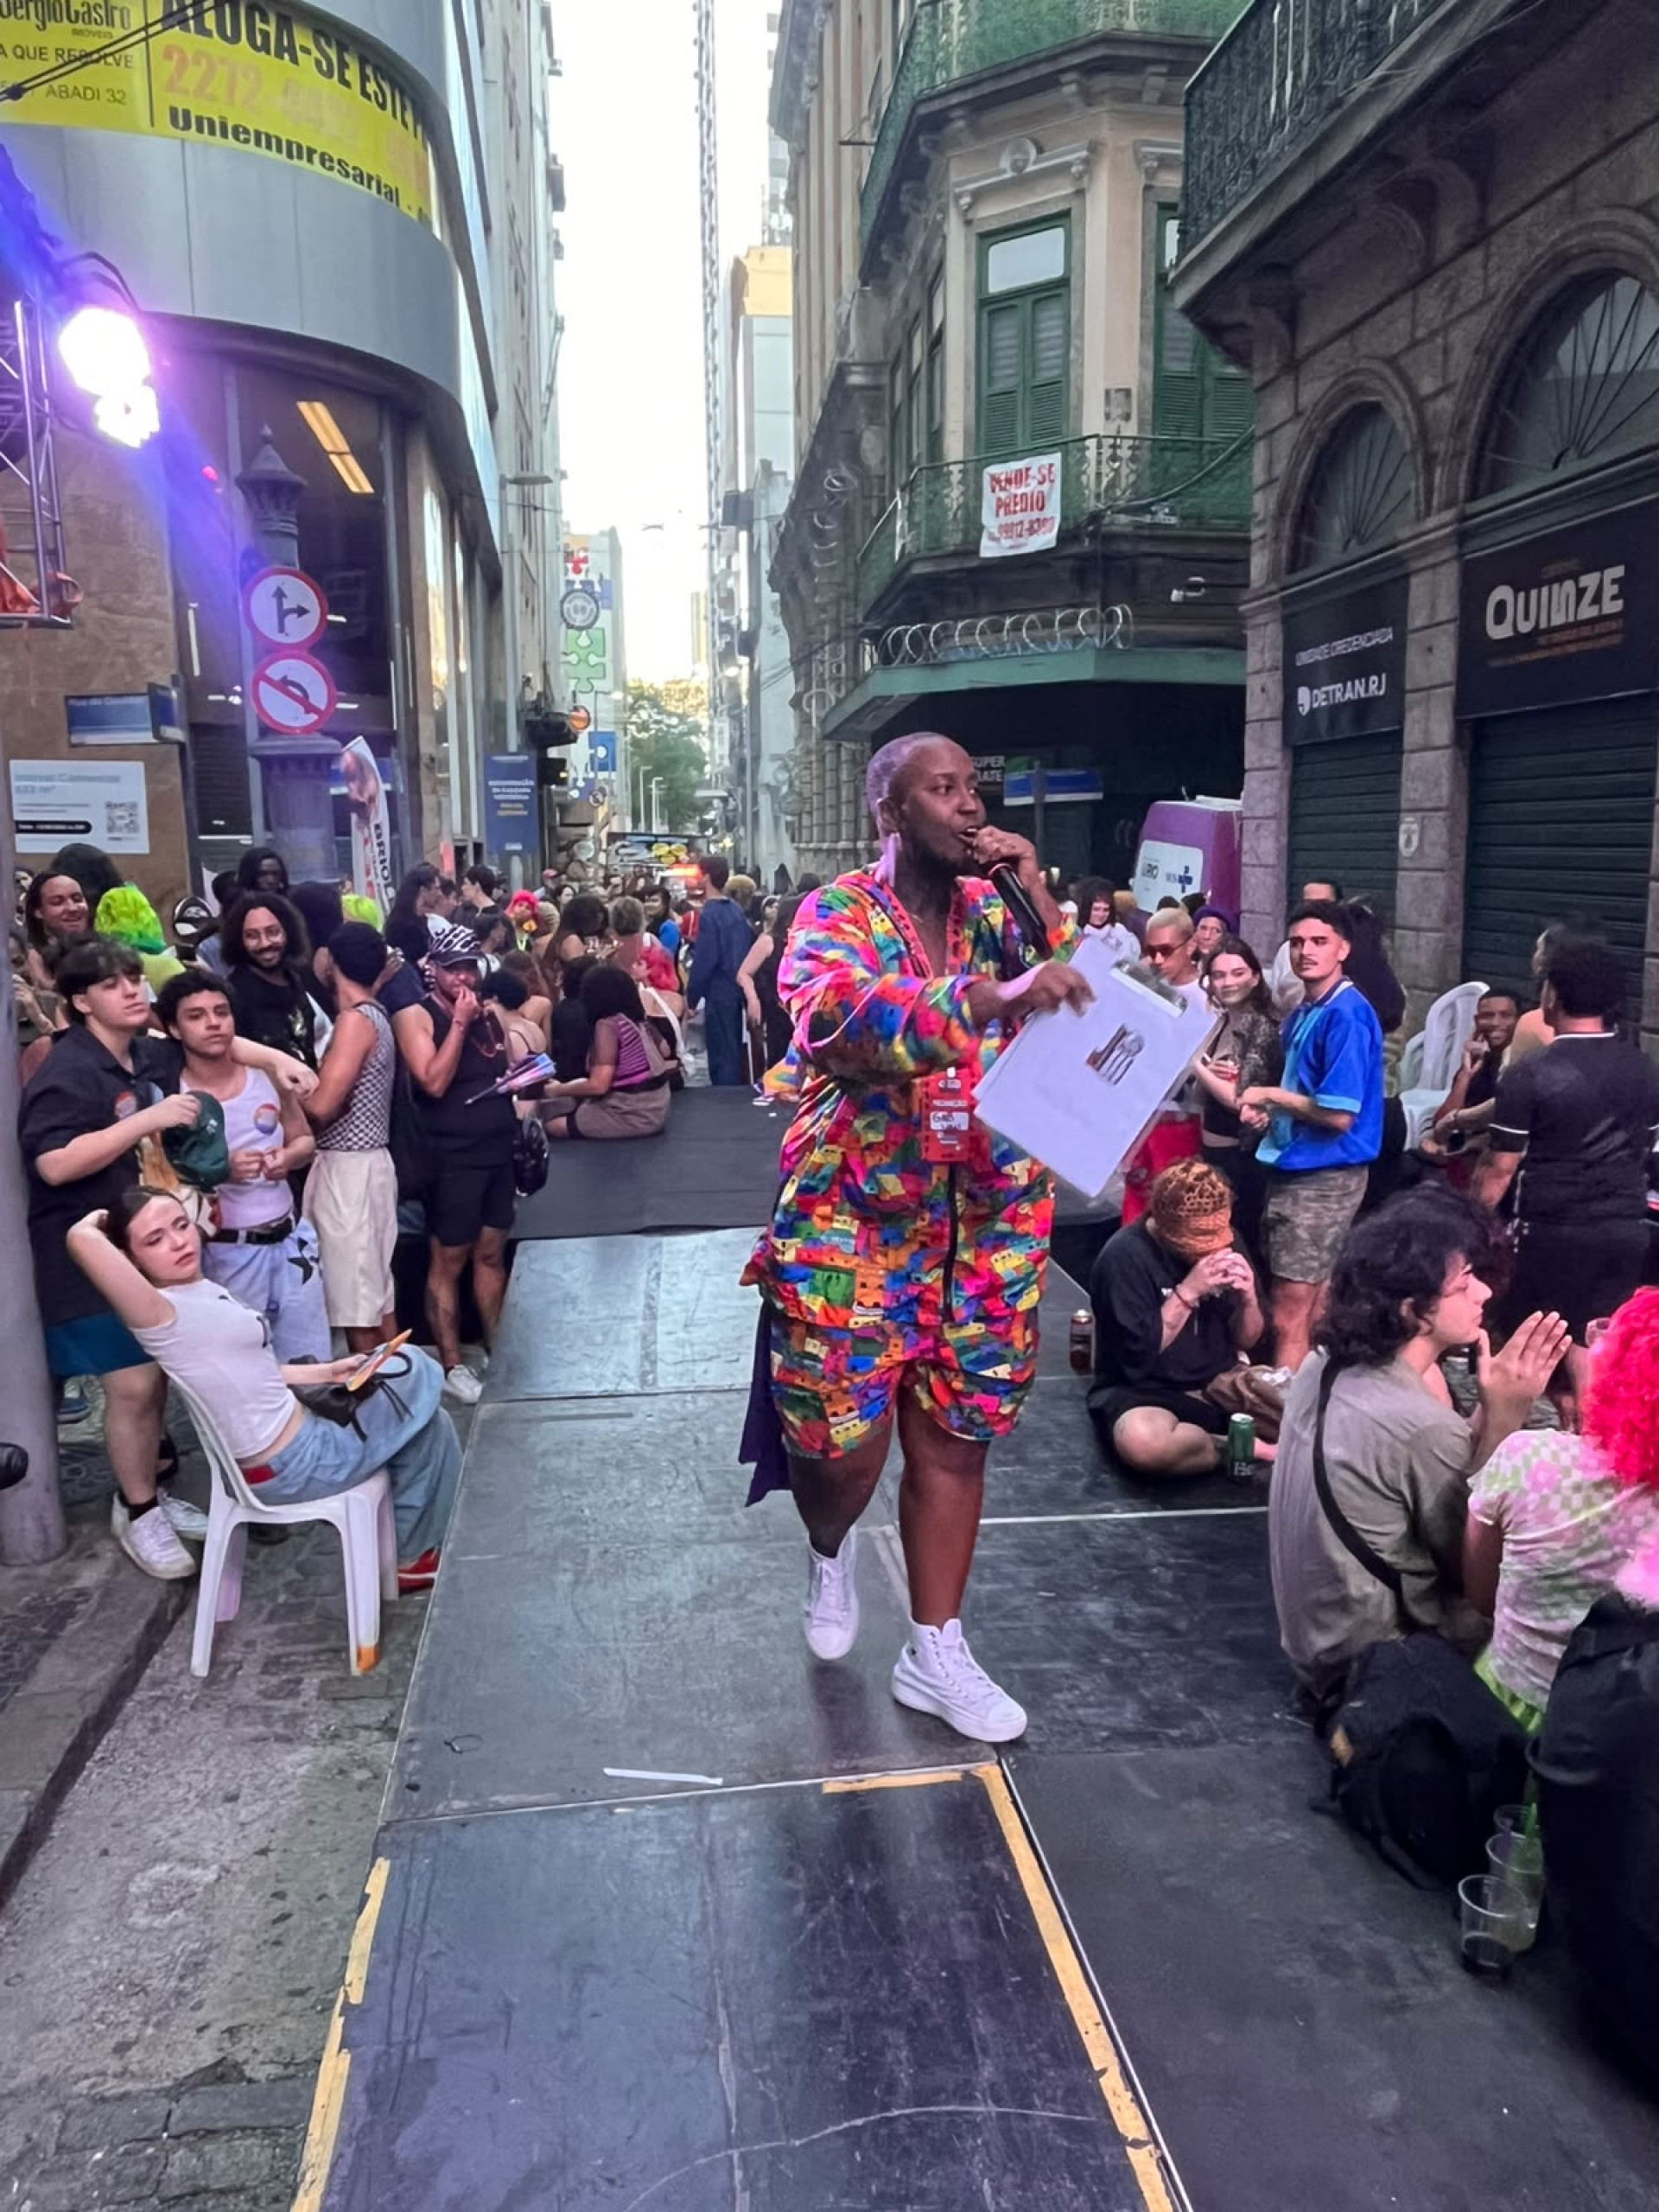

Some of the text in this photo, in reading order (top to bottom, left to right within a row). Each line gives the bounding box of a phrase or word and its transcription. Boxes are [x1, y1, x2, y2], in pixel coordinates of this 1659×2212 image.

[12, 45, 49, 61] QUE
[54, 48, 133, 69] RESLVE
[45, 84, 101, 102] ABADI
[105, 87, 128, 105] 32
[168, 105, 401, 208] Uniempresarial
[1485, 564, 1625, 640] QUINZE
[1312, 672, 1387, 709] DETRAN.RJ
